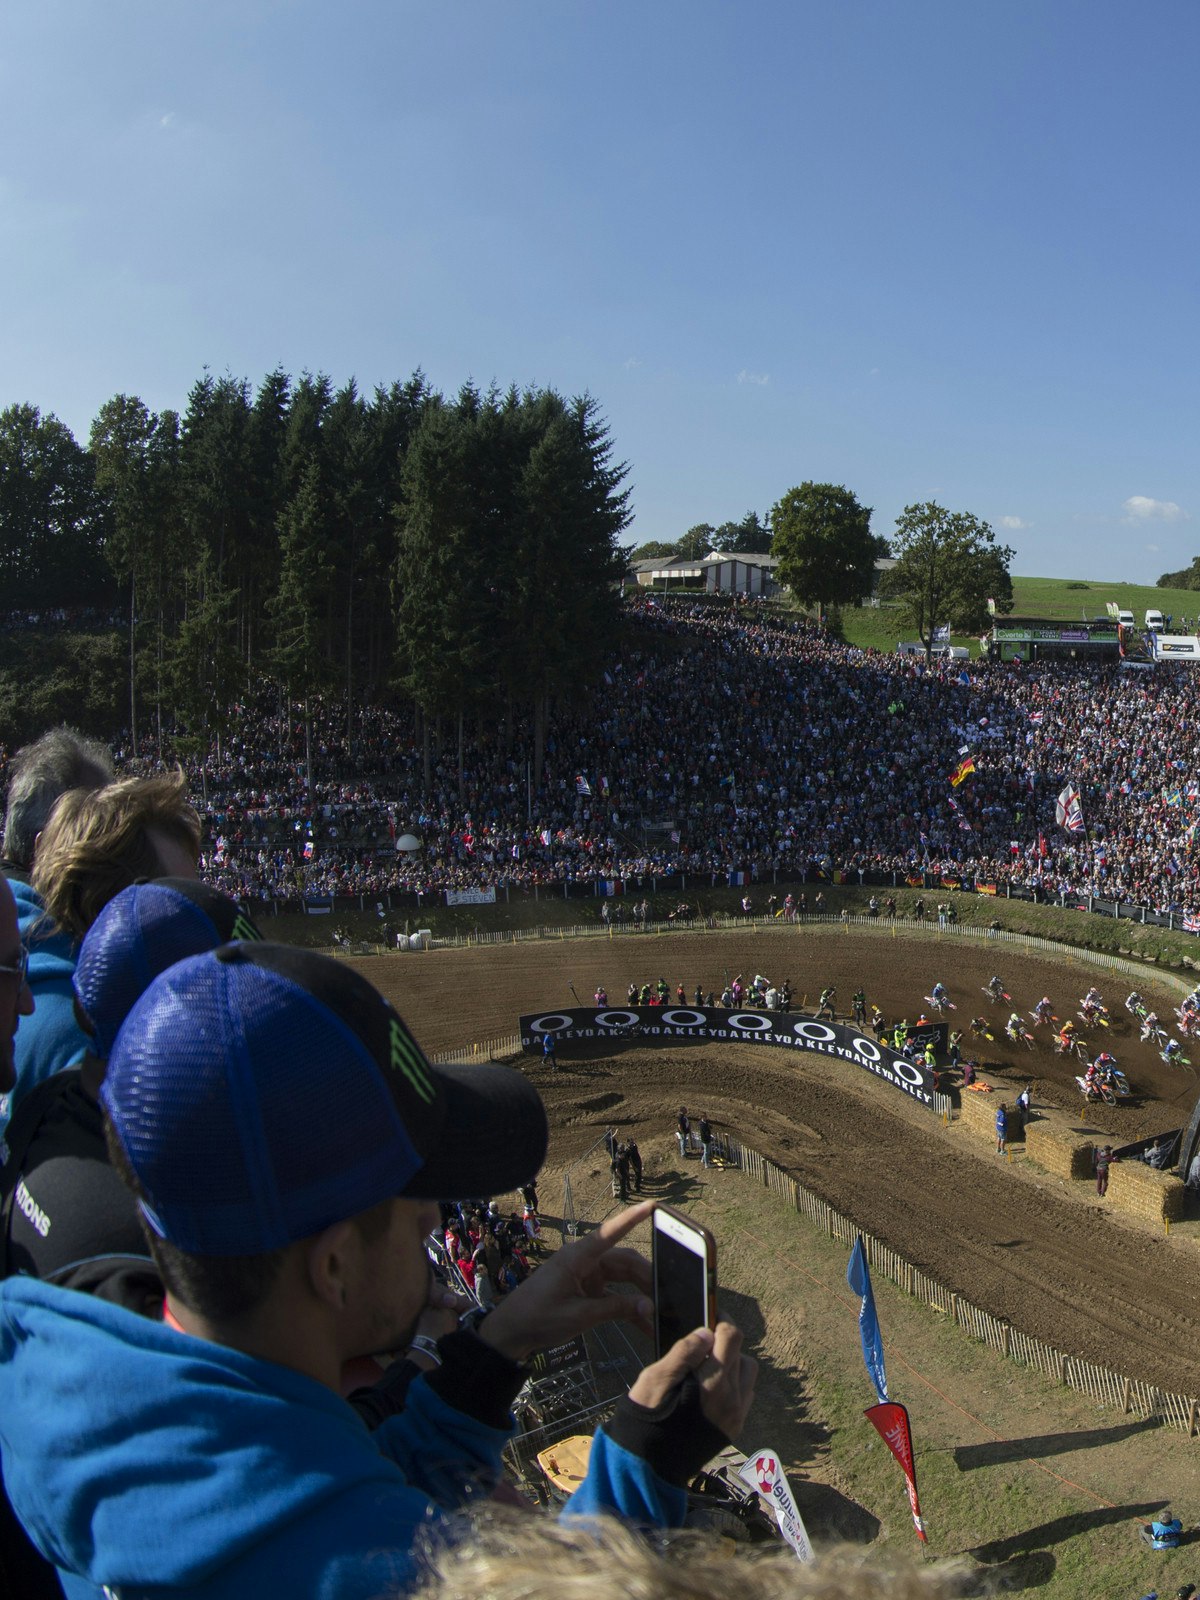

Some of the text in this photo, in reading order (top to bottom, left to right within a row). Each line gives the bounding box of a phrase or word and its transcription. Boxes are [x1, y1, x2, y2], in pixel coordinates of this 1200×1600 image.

[462, 895, 495, 903] STEVEN
[522, 1028, 586, 1046] OALEY
[652, 1026, 719, 1037] OAKLEY
[718, 1029, 783, 1043] OAKLEY
[783, 1035, 845, 1056] OAKLEY
[845, 1048, 887, 1077] OAKLEY
[886, 1071, 931, 1103] OAKLEY
